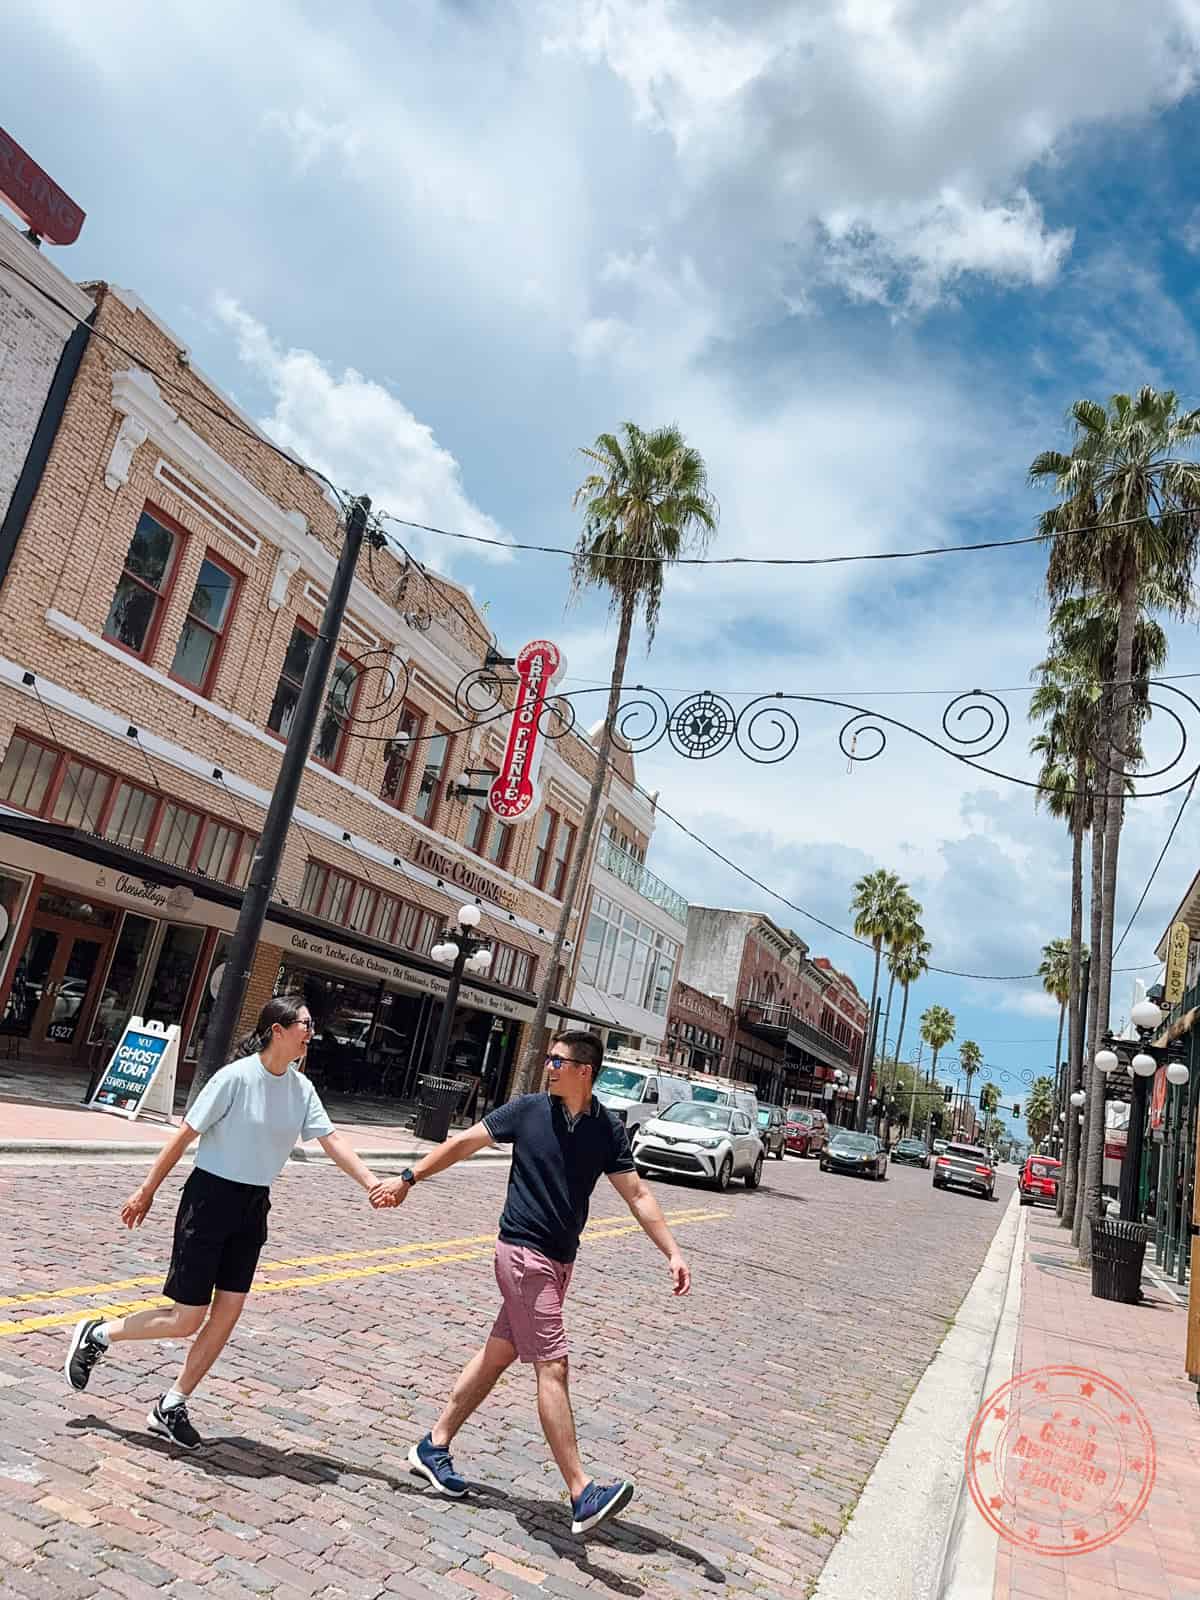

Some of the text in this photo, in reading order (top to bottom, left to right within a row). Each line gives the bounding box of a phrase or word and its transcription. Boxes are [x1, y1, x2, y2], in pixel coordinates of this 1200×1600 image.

[504, 727, 530, 800] FUENTE
[492, 790, 530, 816] CIGARS
[415, 840, 452, 876] KING
[452, 860, 503, 901] CORONA
[1171, 970, 1181, 996] BOX
[50, 1025, 73, 1039] 1527
[118, 1046, 161, 1065] GHOST
[117, 1060, 149, 1079] TOUR
